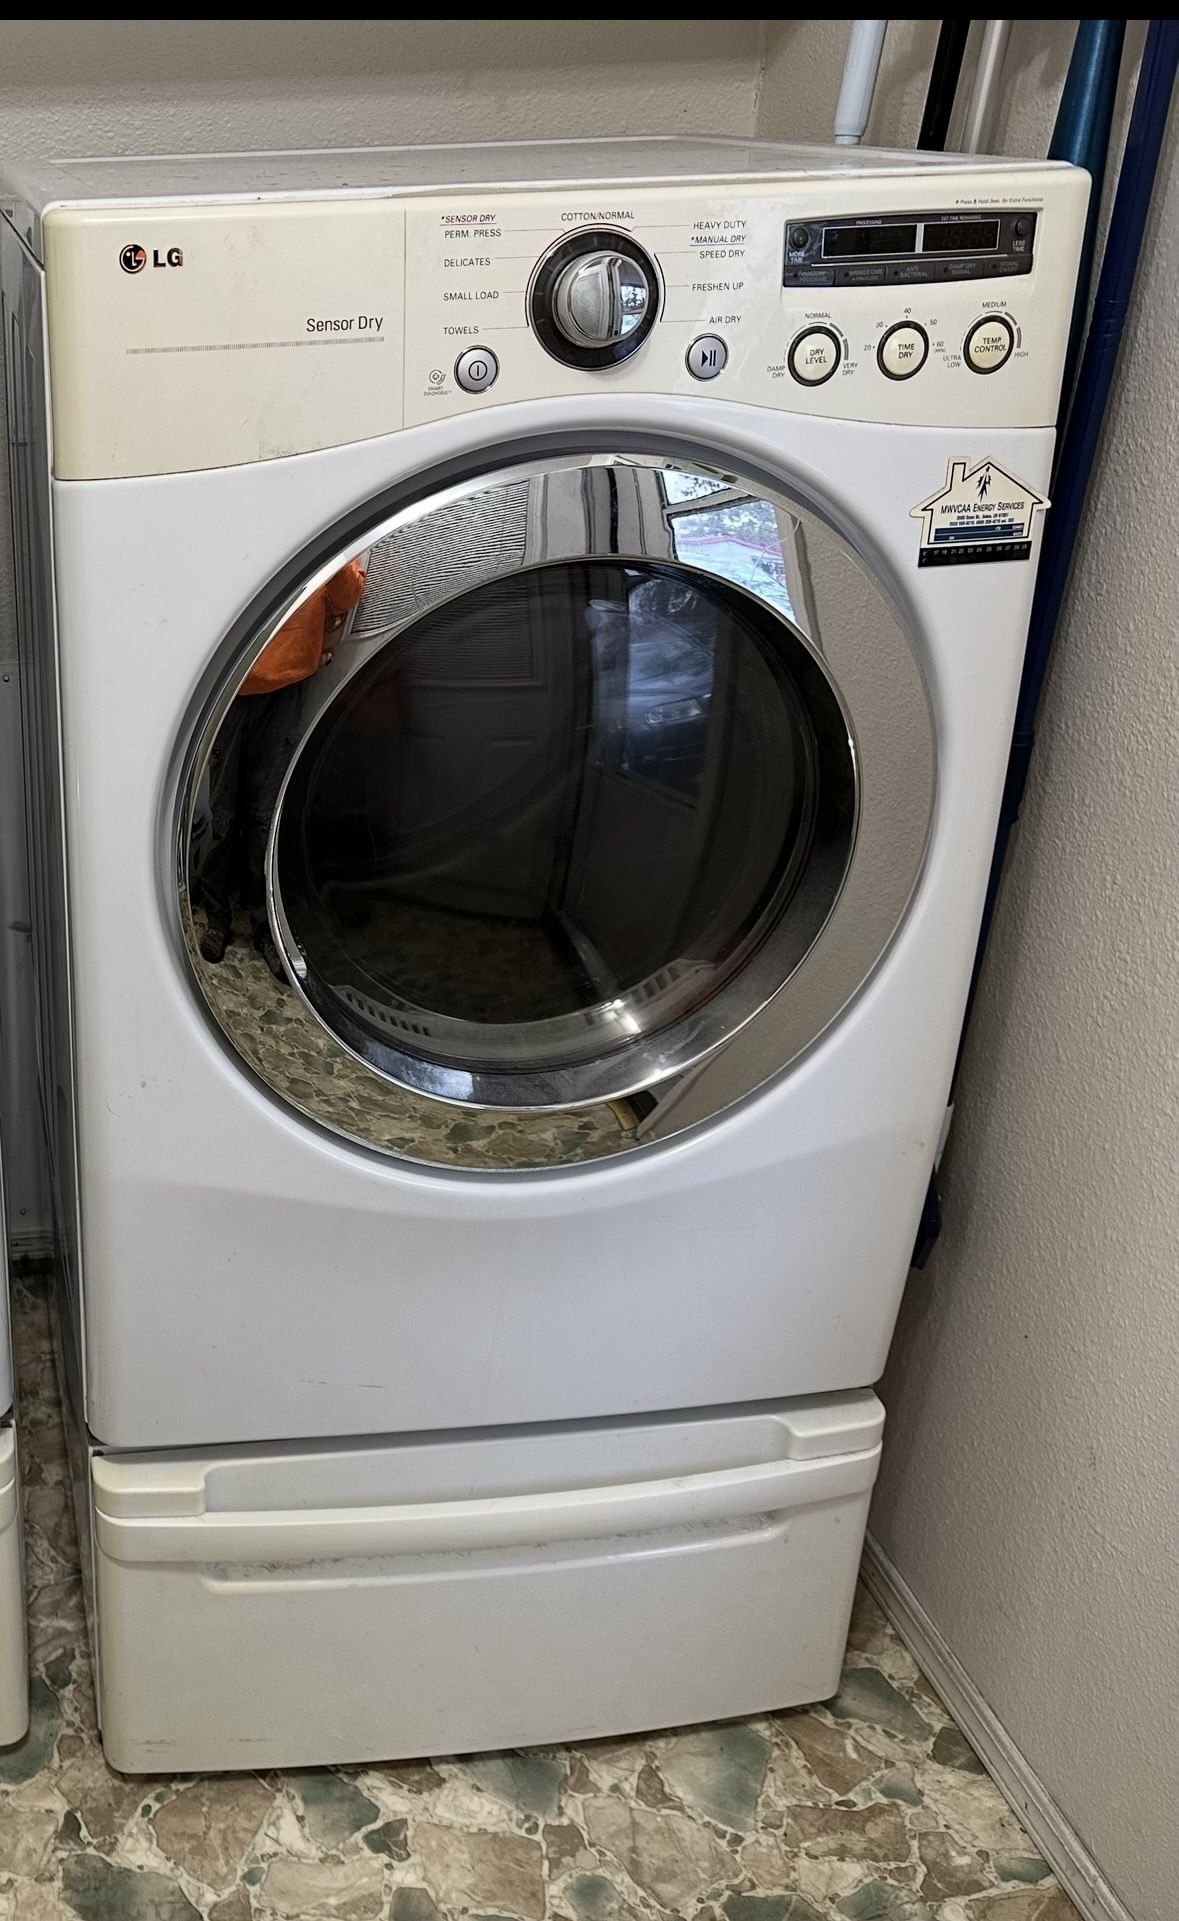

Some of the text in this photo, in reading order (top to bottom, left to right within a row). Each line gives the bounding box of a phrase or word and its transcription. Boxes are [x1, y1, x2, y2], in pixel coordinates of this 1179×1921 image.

[479, 214, 496, 222] DRY
[561, 211, 635, 221] COTTON/NORMAL
[693, 220, 747, 229] HEAVY DUTY
[473, 229, 502, 237] PRESS
[730, 235, 747, 243] DRY
[153, 248, 184, 268] LG
[699, 250, 746, 259] SPEED DRY
[444, 257, 491, 267] DELICATES
[692, 282, 745, 291] FRESHEN UP
[443, 291, 500, 301] SMALL LOAD
[306, 315, 384, 333] Sensor Dry
[709, 315, 742, 324] AIR DRY
[443, 326, 480, 335] TOWELS
[898, 343, 915, 351] TIME
[974, 344, 1007, 353] CONTROL
[809, 348, 825, 356] DRY
[898, 351, 914, 359] DRY
[805, 356, 827, 365] LEVEL
[941, 503, 971, 514] MWVCAA
